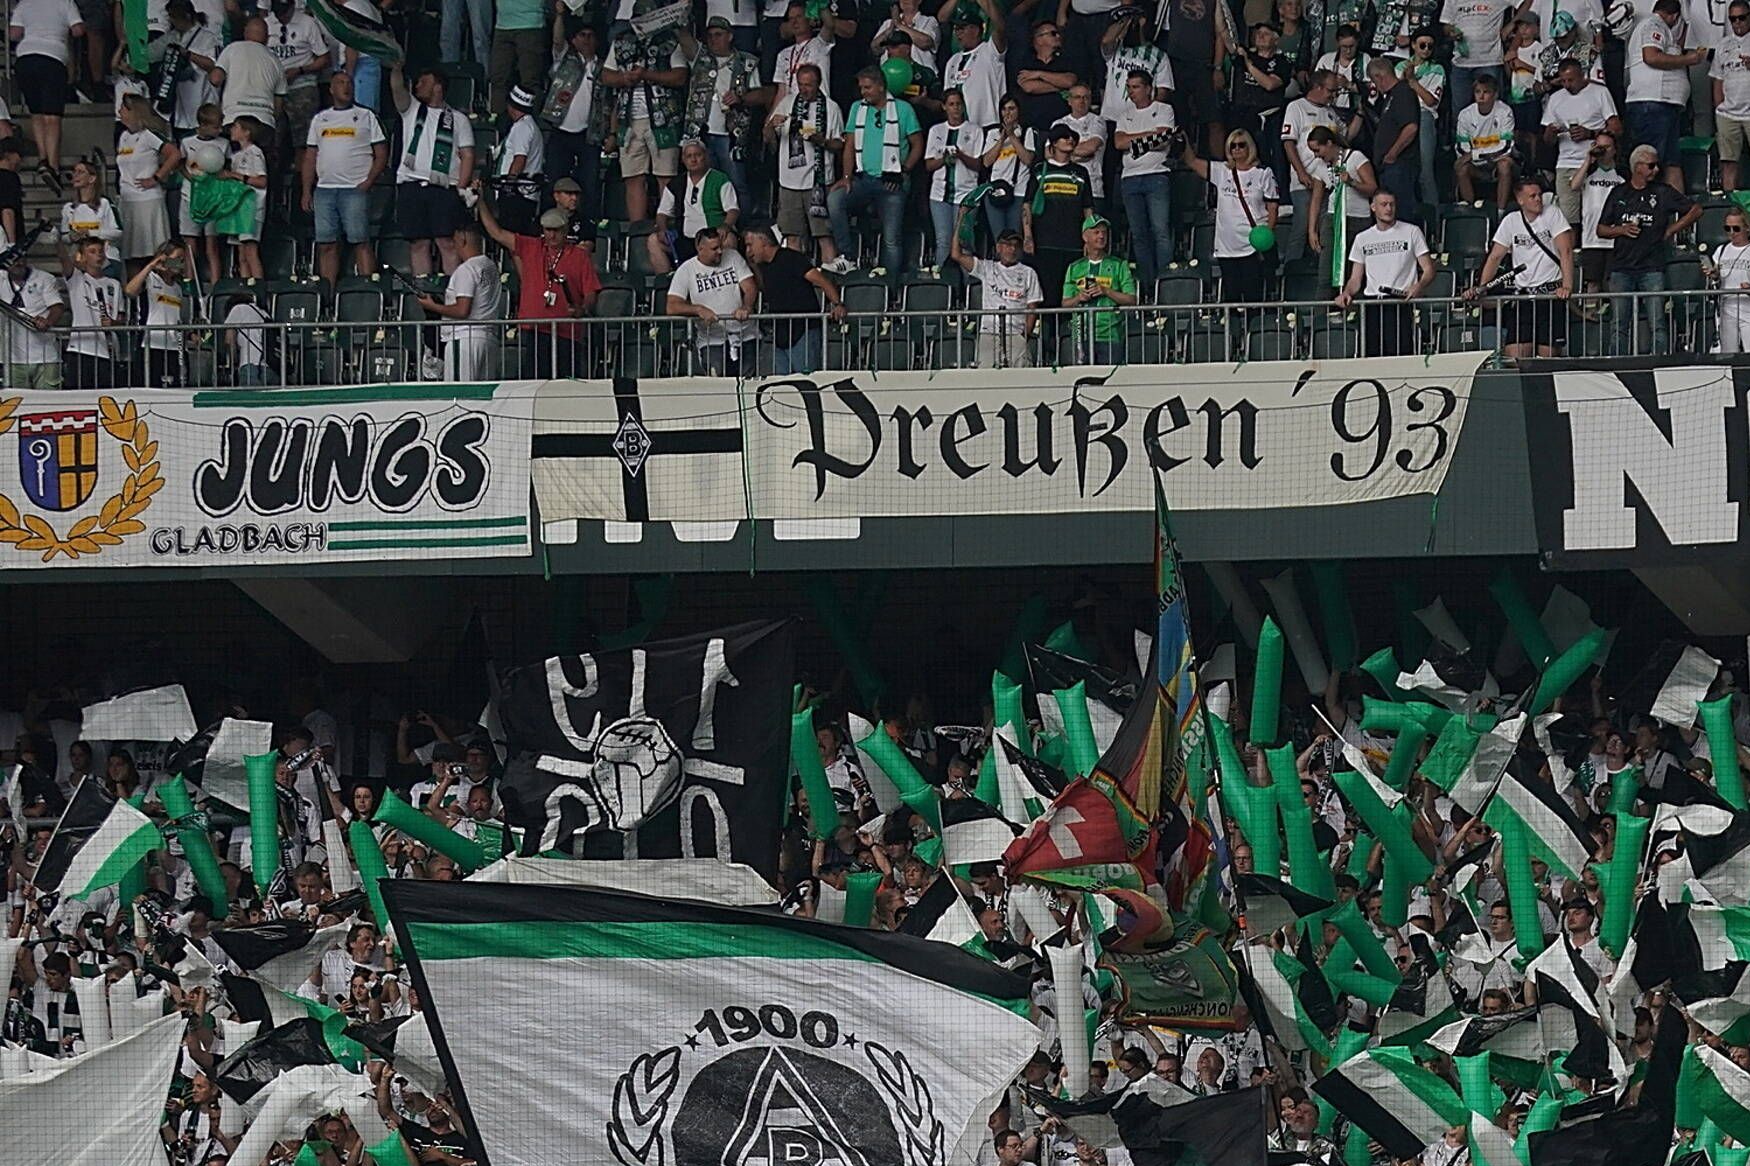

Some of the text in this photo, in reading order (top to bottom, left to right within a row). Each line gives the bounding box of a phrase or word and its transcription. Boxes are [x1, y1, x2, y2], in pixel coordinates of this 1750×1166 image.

[697, 270, 739, 294] BENLEE
[756, 374, 1263, 503] Preußen
[193, 410, 492, 518] JUNGS
[152, 523, 328, 556] GLADBACH
[694, 1004, 839, 1048] 1900
